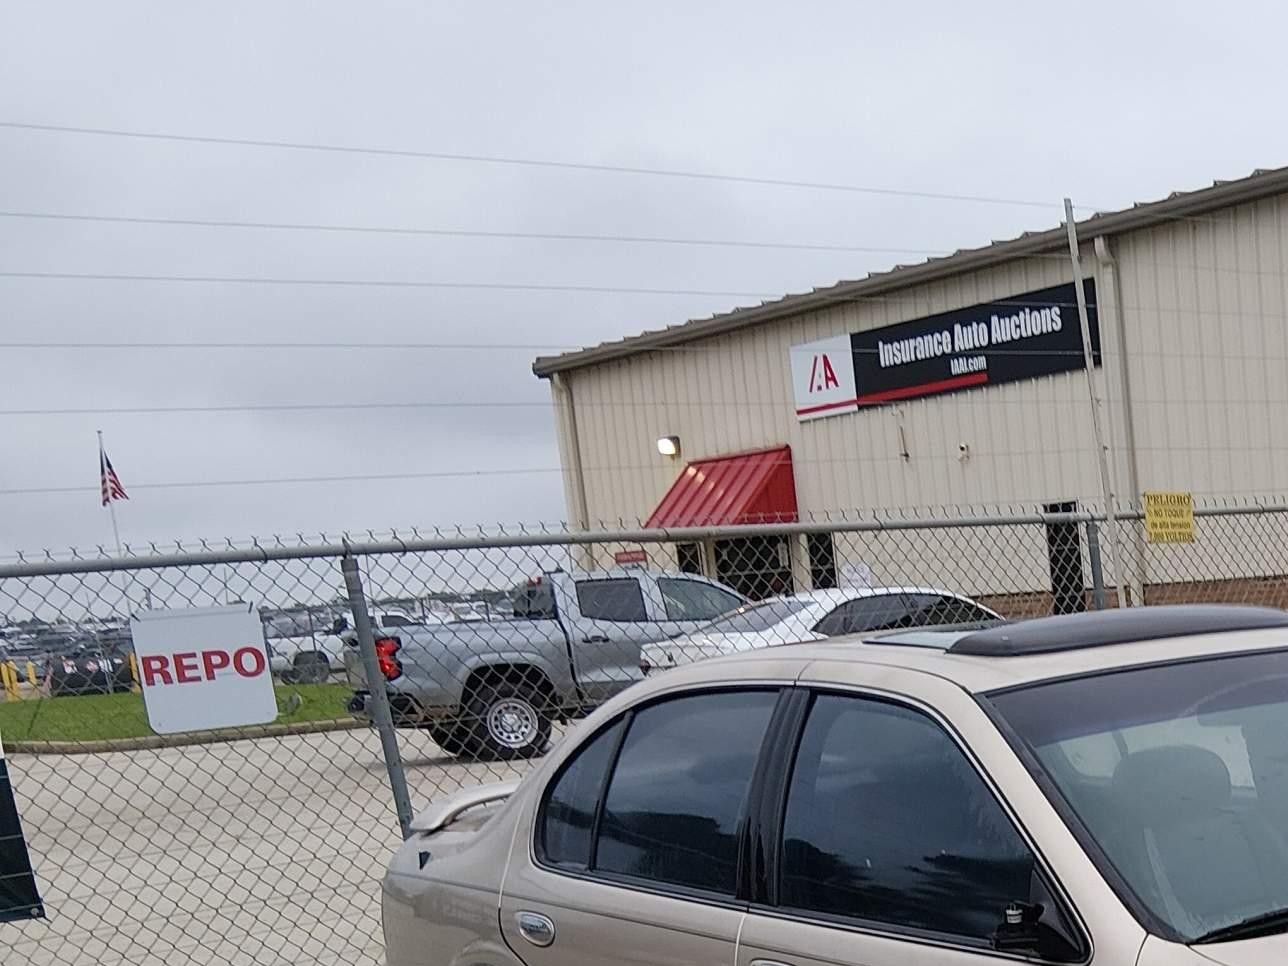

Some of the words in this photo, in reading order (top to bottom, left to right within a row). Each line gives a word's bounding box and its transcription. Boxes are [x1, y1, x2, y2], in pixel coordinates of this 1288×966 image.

[878, 329, 952, 368] Insurance
[953, 321, 989, 352] Auto
[991, 306, 1063, 345] Auctions
[950, 355, 988, 376] IAAI.com
[1146, 494, 1191, 506] PELIGRO
[140, 646, 266, 686] REPO
